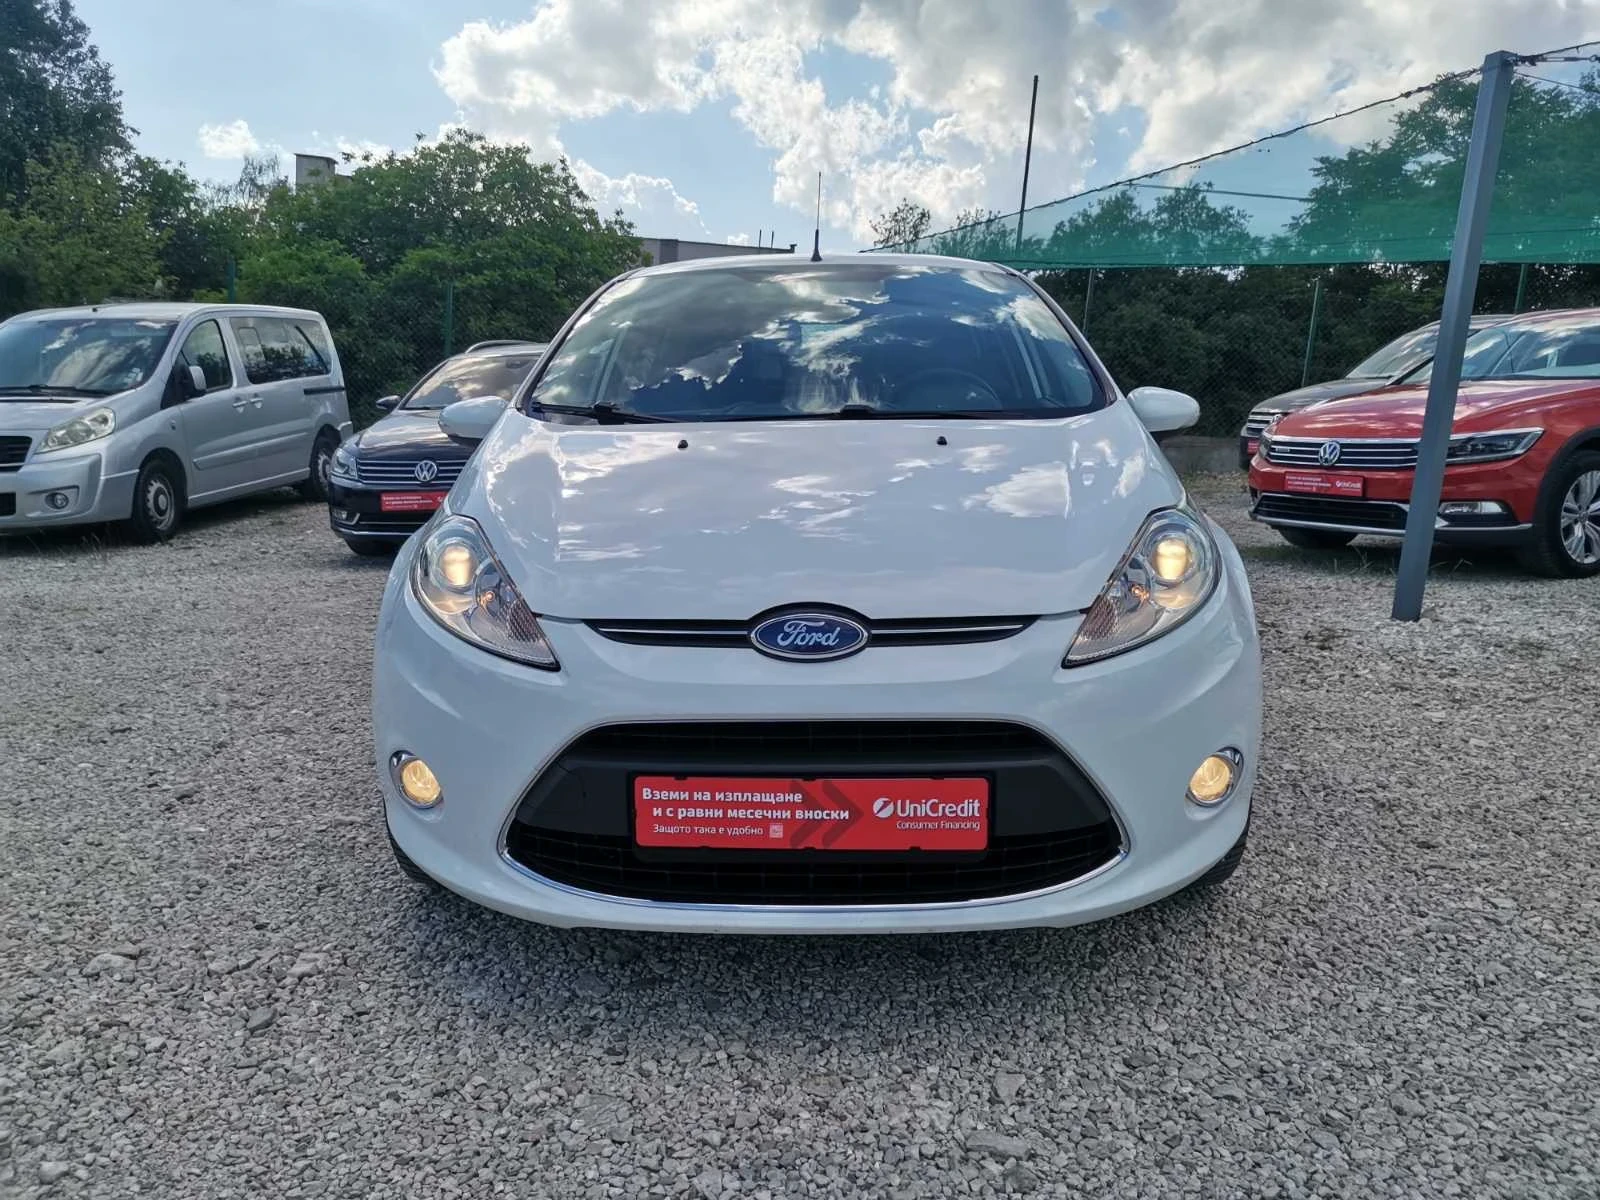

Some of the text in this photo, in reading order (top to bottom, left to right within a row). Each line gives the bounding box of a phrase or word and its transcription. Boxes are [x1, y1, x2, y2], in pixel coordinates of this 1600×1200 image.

[777, 620, 840, 646] Ford
[642, 787, 803, 804] Вземи на изплащане
[652, 806, 662, 817] и
[677, 807, 723, 820] равни
[727, 807, 791, 819] месечни
[795, 809, 849, 820] вноски
[896, 798, 981, 818] UniCredit
[653, 823, 764, 836] Защото така е удобно
[896, 821, 980, 832] Consumer Financing
